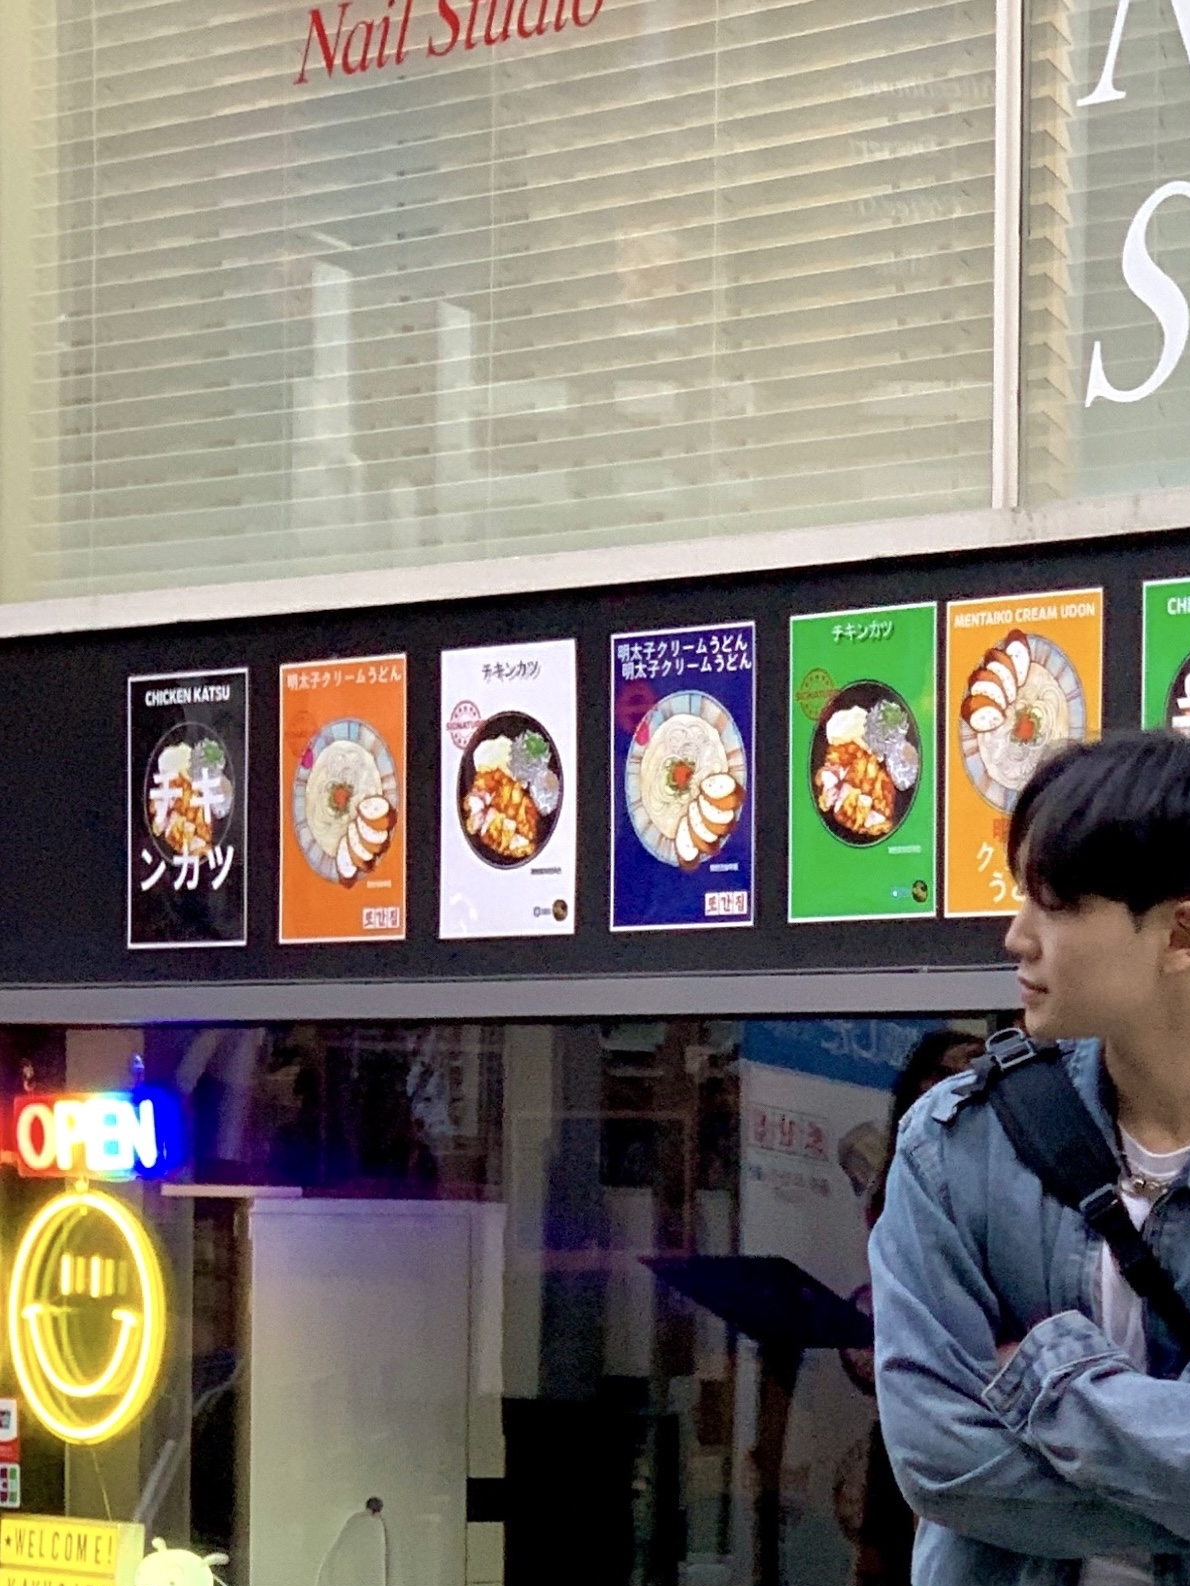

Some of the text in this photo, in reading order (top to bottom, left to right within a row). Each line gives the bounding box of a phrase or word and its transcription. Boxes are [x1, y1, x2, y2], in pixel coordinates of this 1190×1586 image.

[293, 0, 412, 85] Nail
[954, 602, 1096, 628] MENTAIKO CREAM UDON
[832, 620, 894, 642] チキンカツ
[617, 634, 748, 662] 明太子クリームうどん
[286, 665, 401, 691] 明太子クリームうどん
[481, 660, 541, 682] チキンカツ
[621, 652, 752, 681] 明太子クリームうどん
[145, 684, 230, 707] CHICKEN KATSU
[140, 845, 235, 892] ンカツ
[17, 1099, 158, 1171] OPEN
[14, 1527, 113, 1565] WELCOME!
